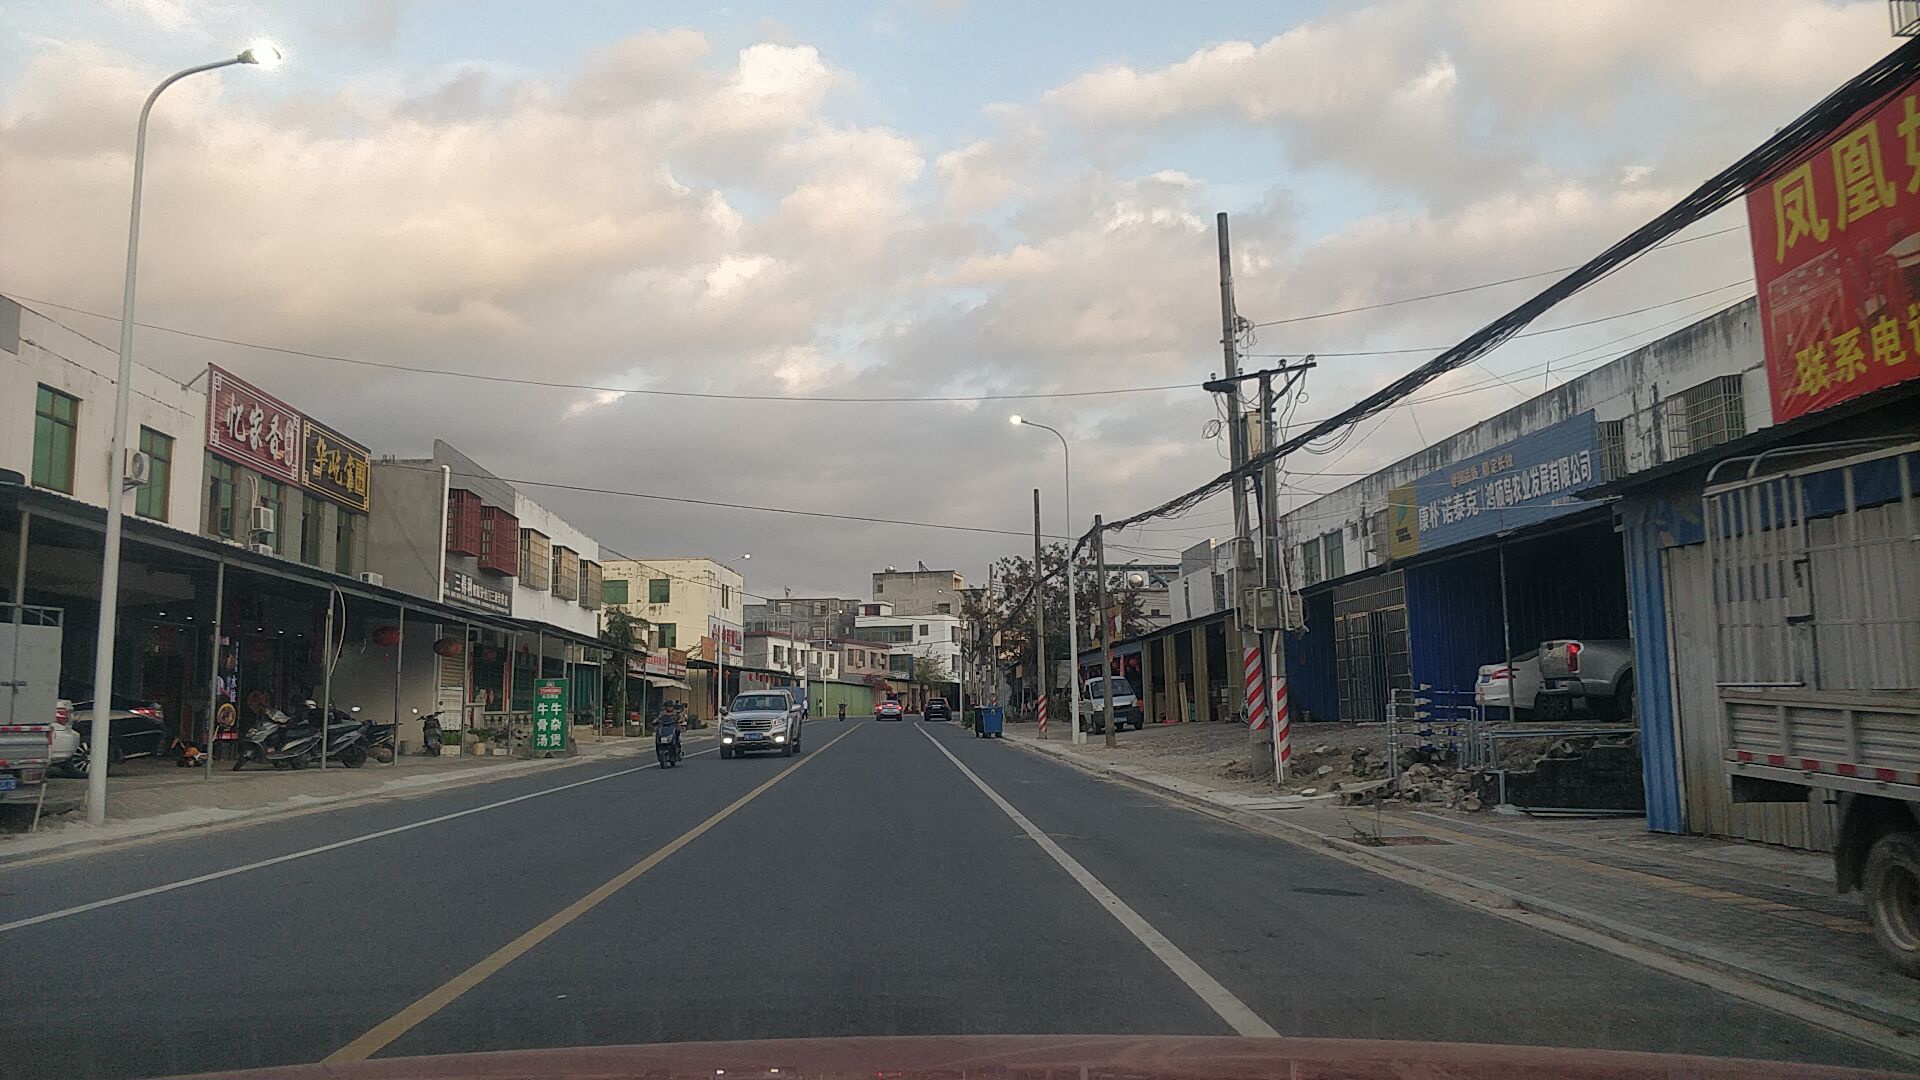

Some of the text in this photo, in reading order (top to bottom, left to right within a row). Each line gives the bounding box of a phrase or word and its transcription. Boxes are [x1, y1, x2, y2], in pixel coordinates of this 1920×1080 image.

[536, 702, 549, 747] 牛骨汤
[550, 702, 563, 747] 牛杂煲
